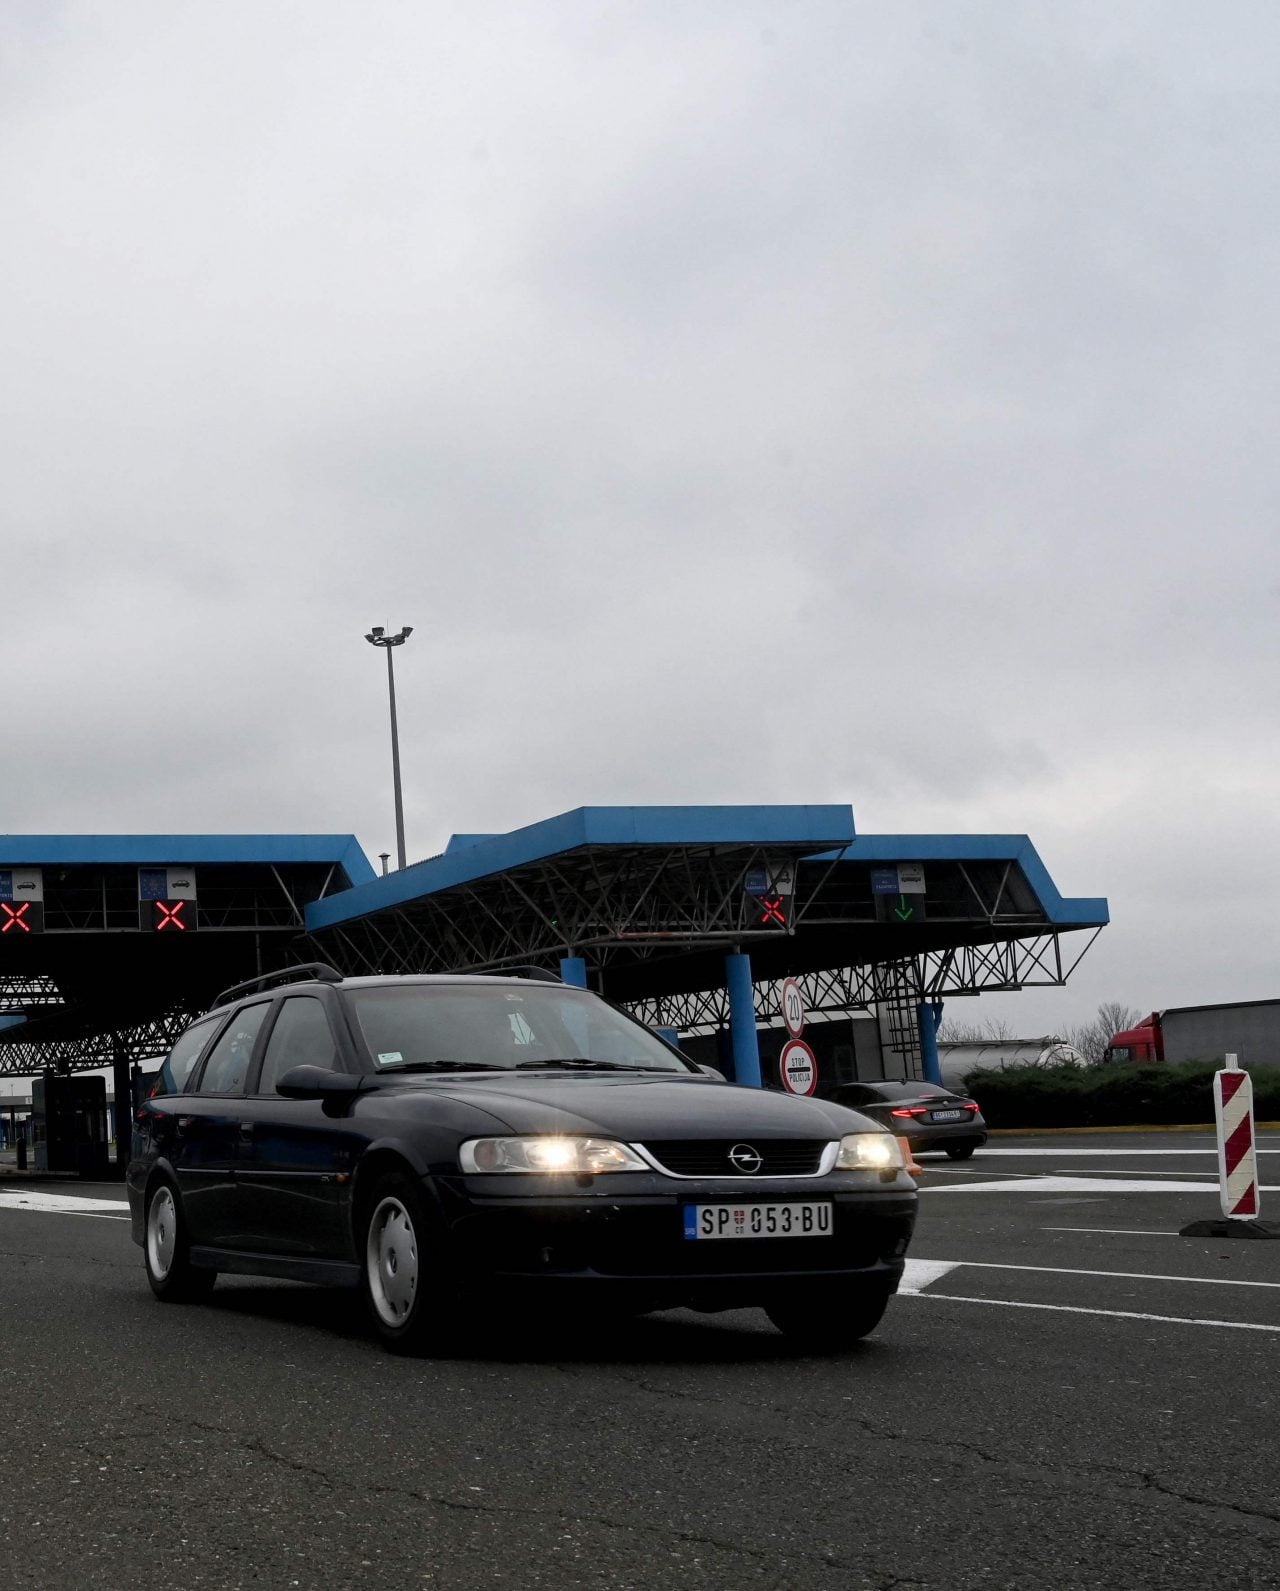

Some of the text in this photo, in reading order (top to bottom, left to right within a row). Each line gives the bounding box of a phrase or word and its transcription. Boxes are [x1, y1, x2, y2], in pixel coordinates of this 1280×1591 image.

[788, 995, 799, 1020] 20
[792, 1057, 804, 1066] STOP
[789, 1073, 810, 1083] POLICIJA
[702, 1209, 729, 1234] SP
